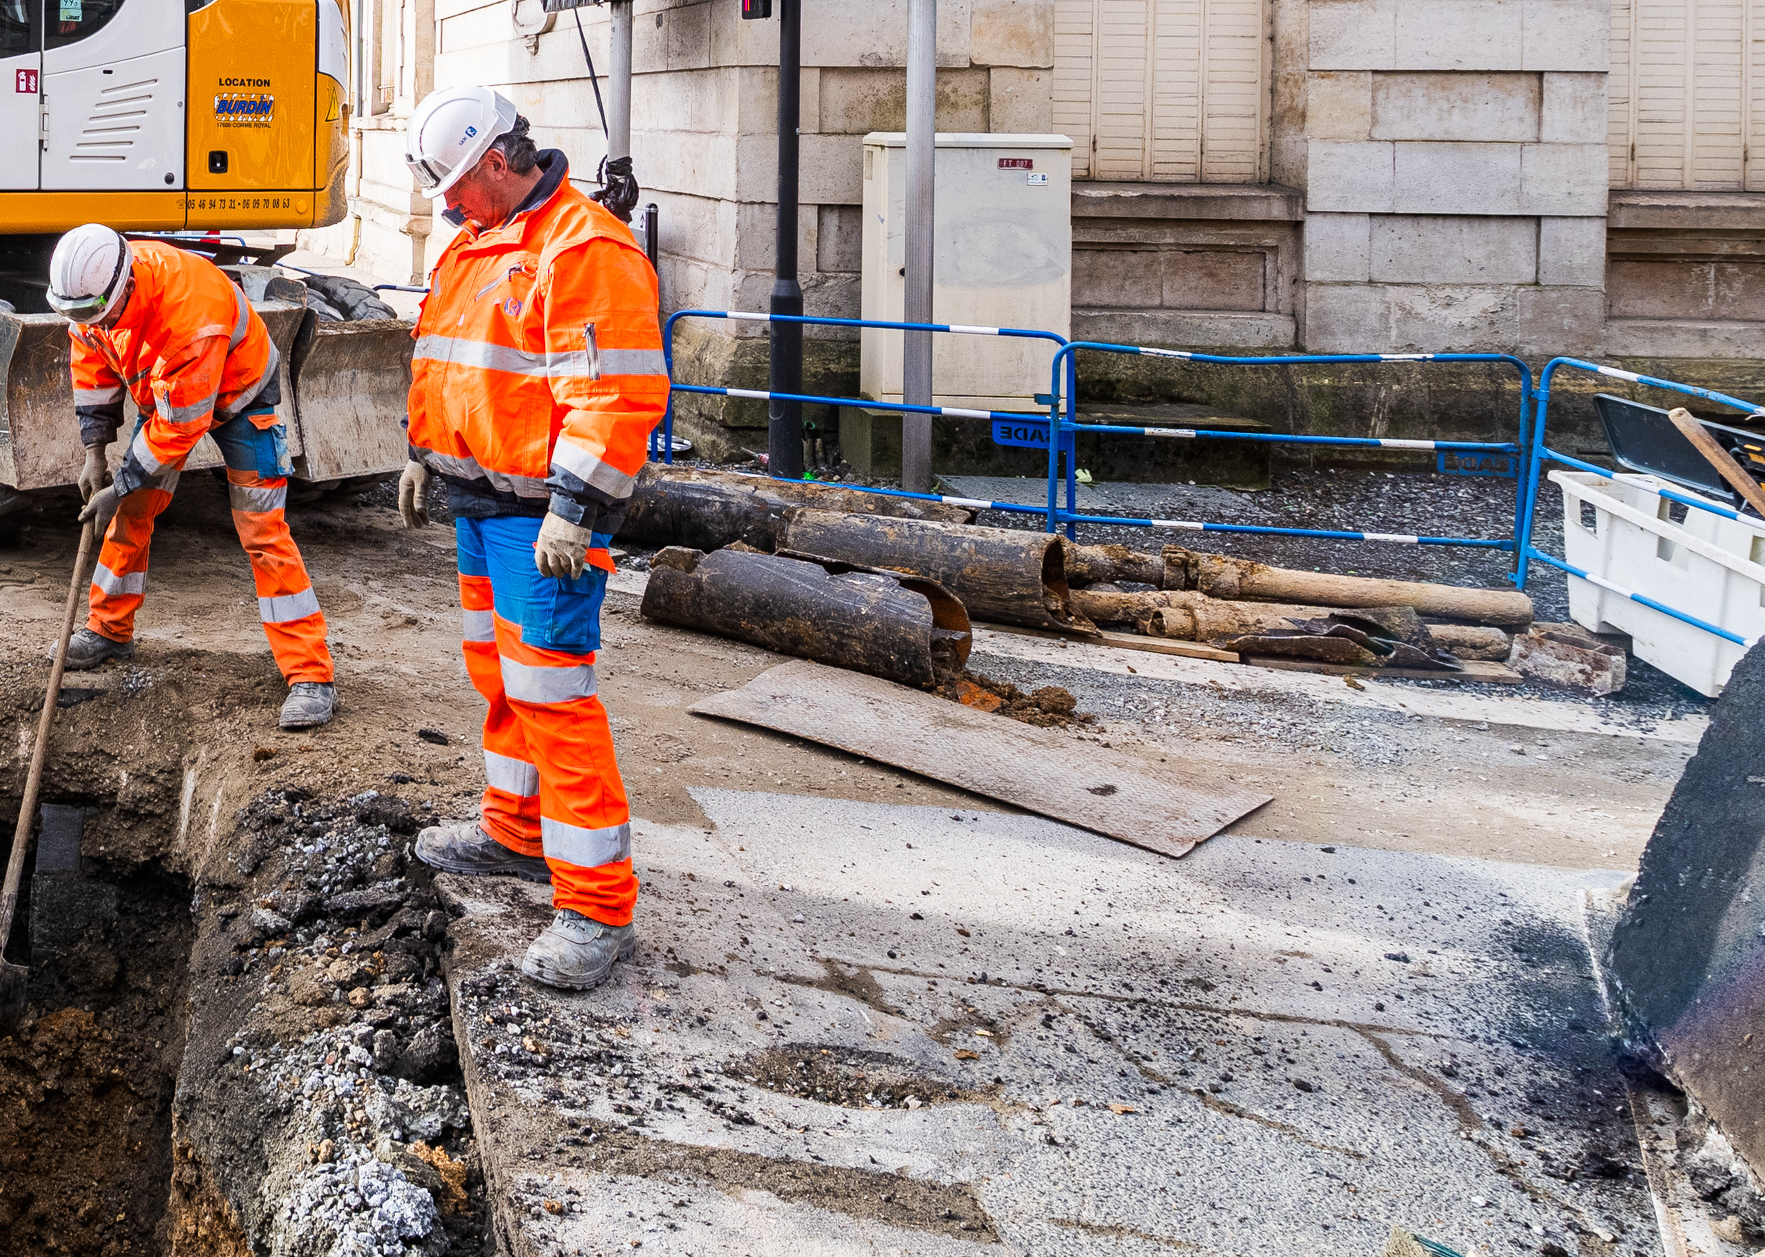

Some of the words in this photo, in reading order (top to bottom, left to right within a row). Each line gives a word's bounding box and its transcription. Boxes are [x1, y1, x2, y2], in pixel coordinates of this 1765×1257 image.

[219, 78, 270, 87] LOCATION
[216, 96, 273, 114] BURDIN
[198, 199, 206, 209] 46
[208, 199, 216, 209] 94
[219, 199, 226, 209] 73
[229, 199, 236, 209] 31
[263, 199, 270, 209] 70
